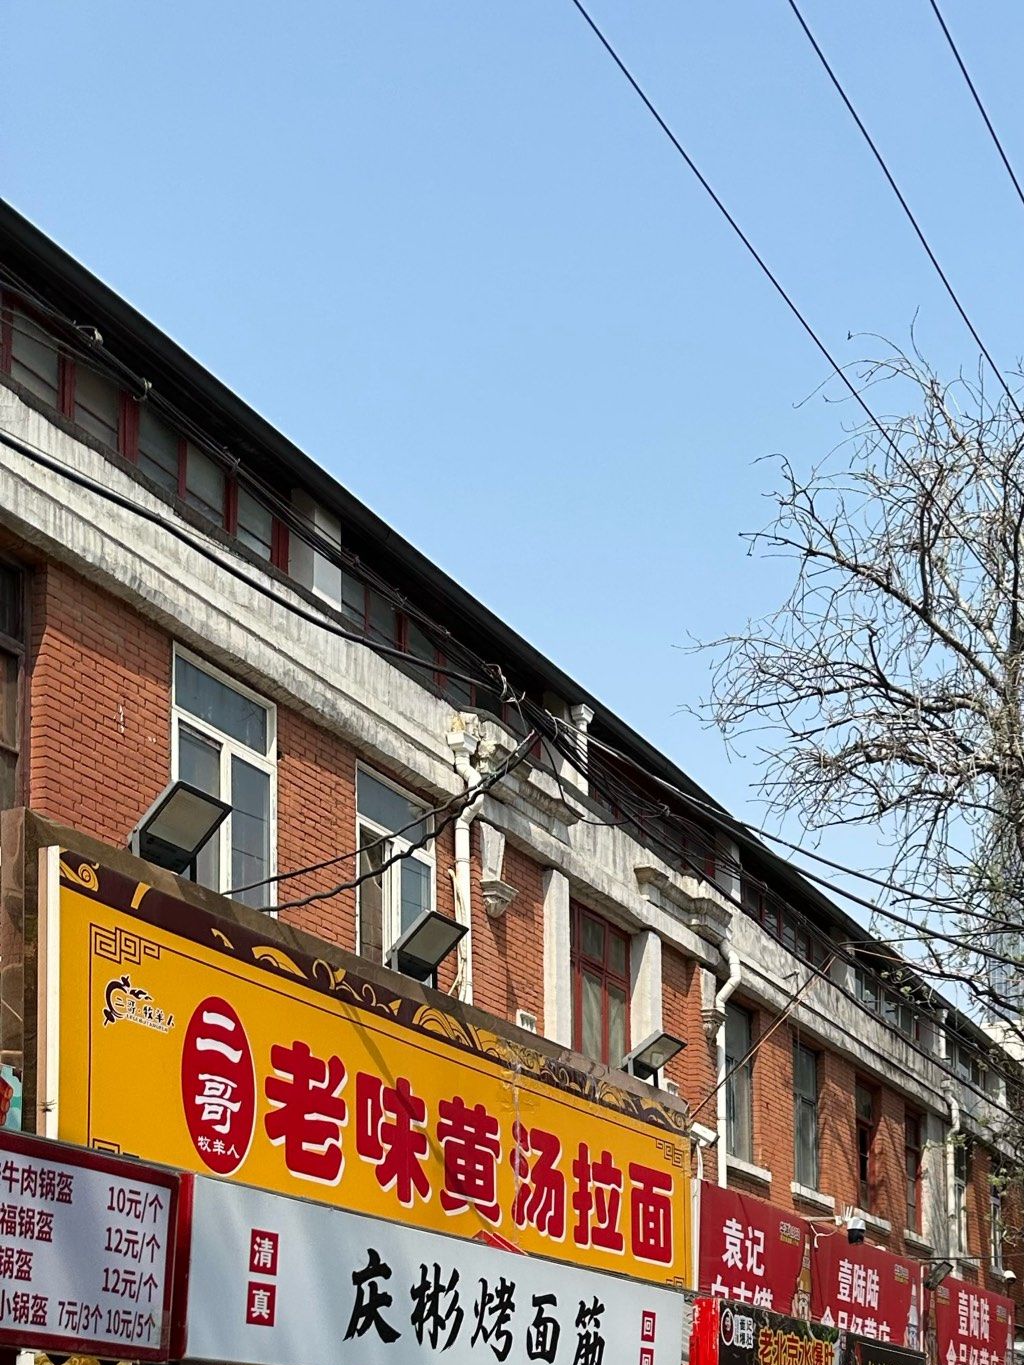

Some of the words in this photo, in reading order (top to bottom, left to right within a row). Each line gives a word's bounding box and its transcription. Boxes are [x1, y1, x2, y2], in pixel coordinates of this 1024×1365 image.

[197, 1135, 240, 1159] 牧羊人
[264, 1040, 675, 1268] 老味黄汤拉面
[0, 1160, 74, 1205] 牛肉锅盔
[106, 1186, 164, 1224] 10元/个
[104, 1226, 161, 1264] 12元/个
[721, 1217, 766, 1277] 袁记
[101, 1267, 158, 1303] 12元/个
[250, 1235, 275, 1321] 清真
[57, 1301, 103, 1335] 7元/3个
[105, 1309, 156, 1342] 10元/5个
